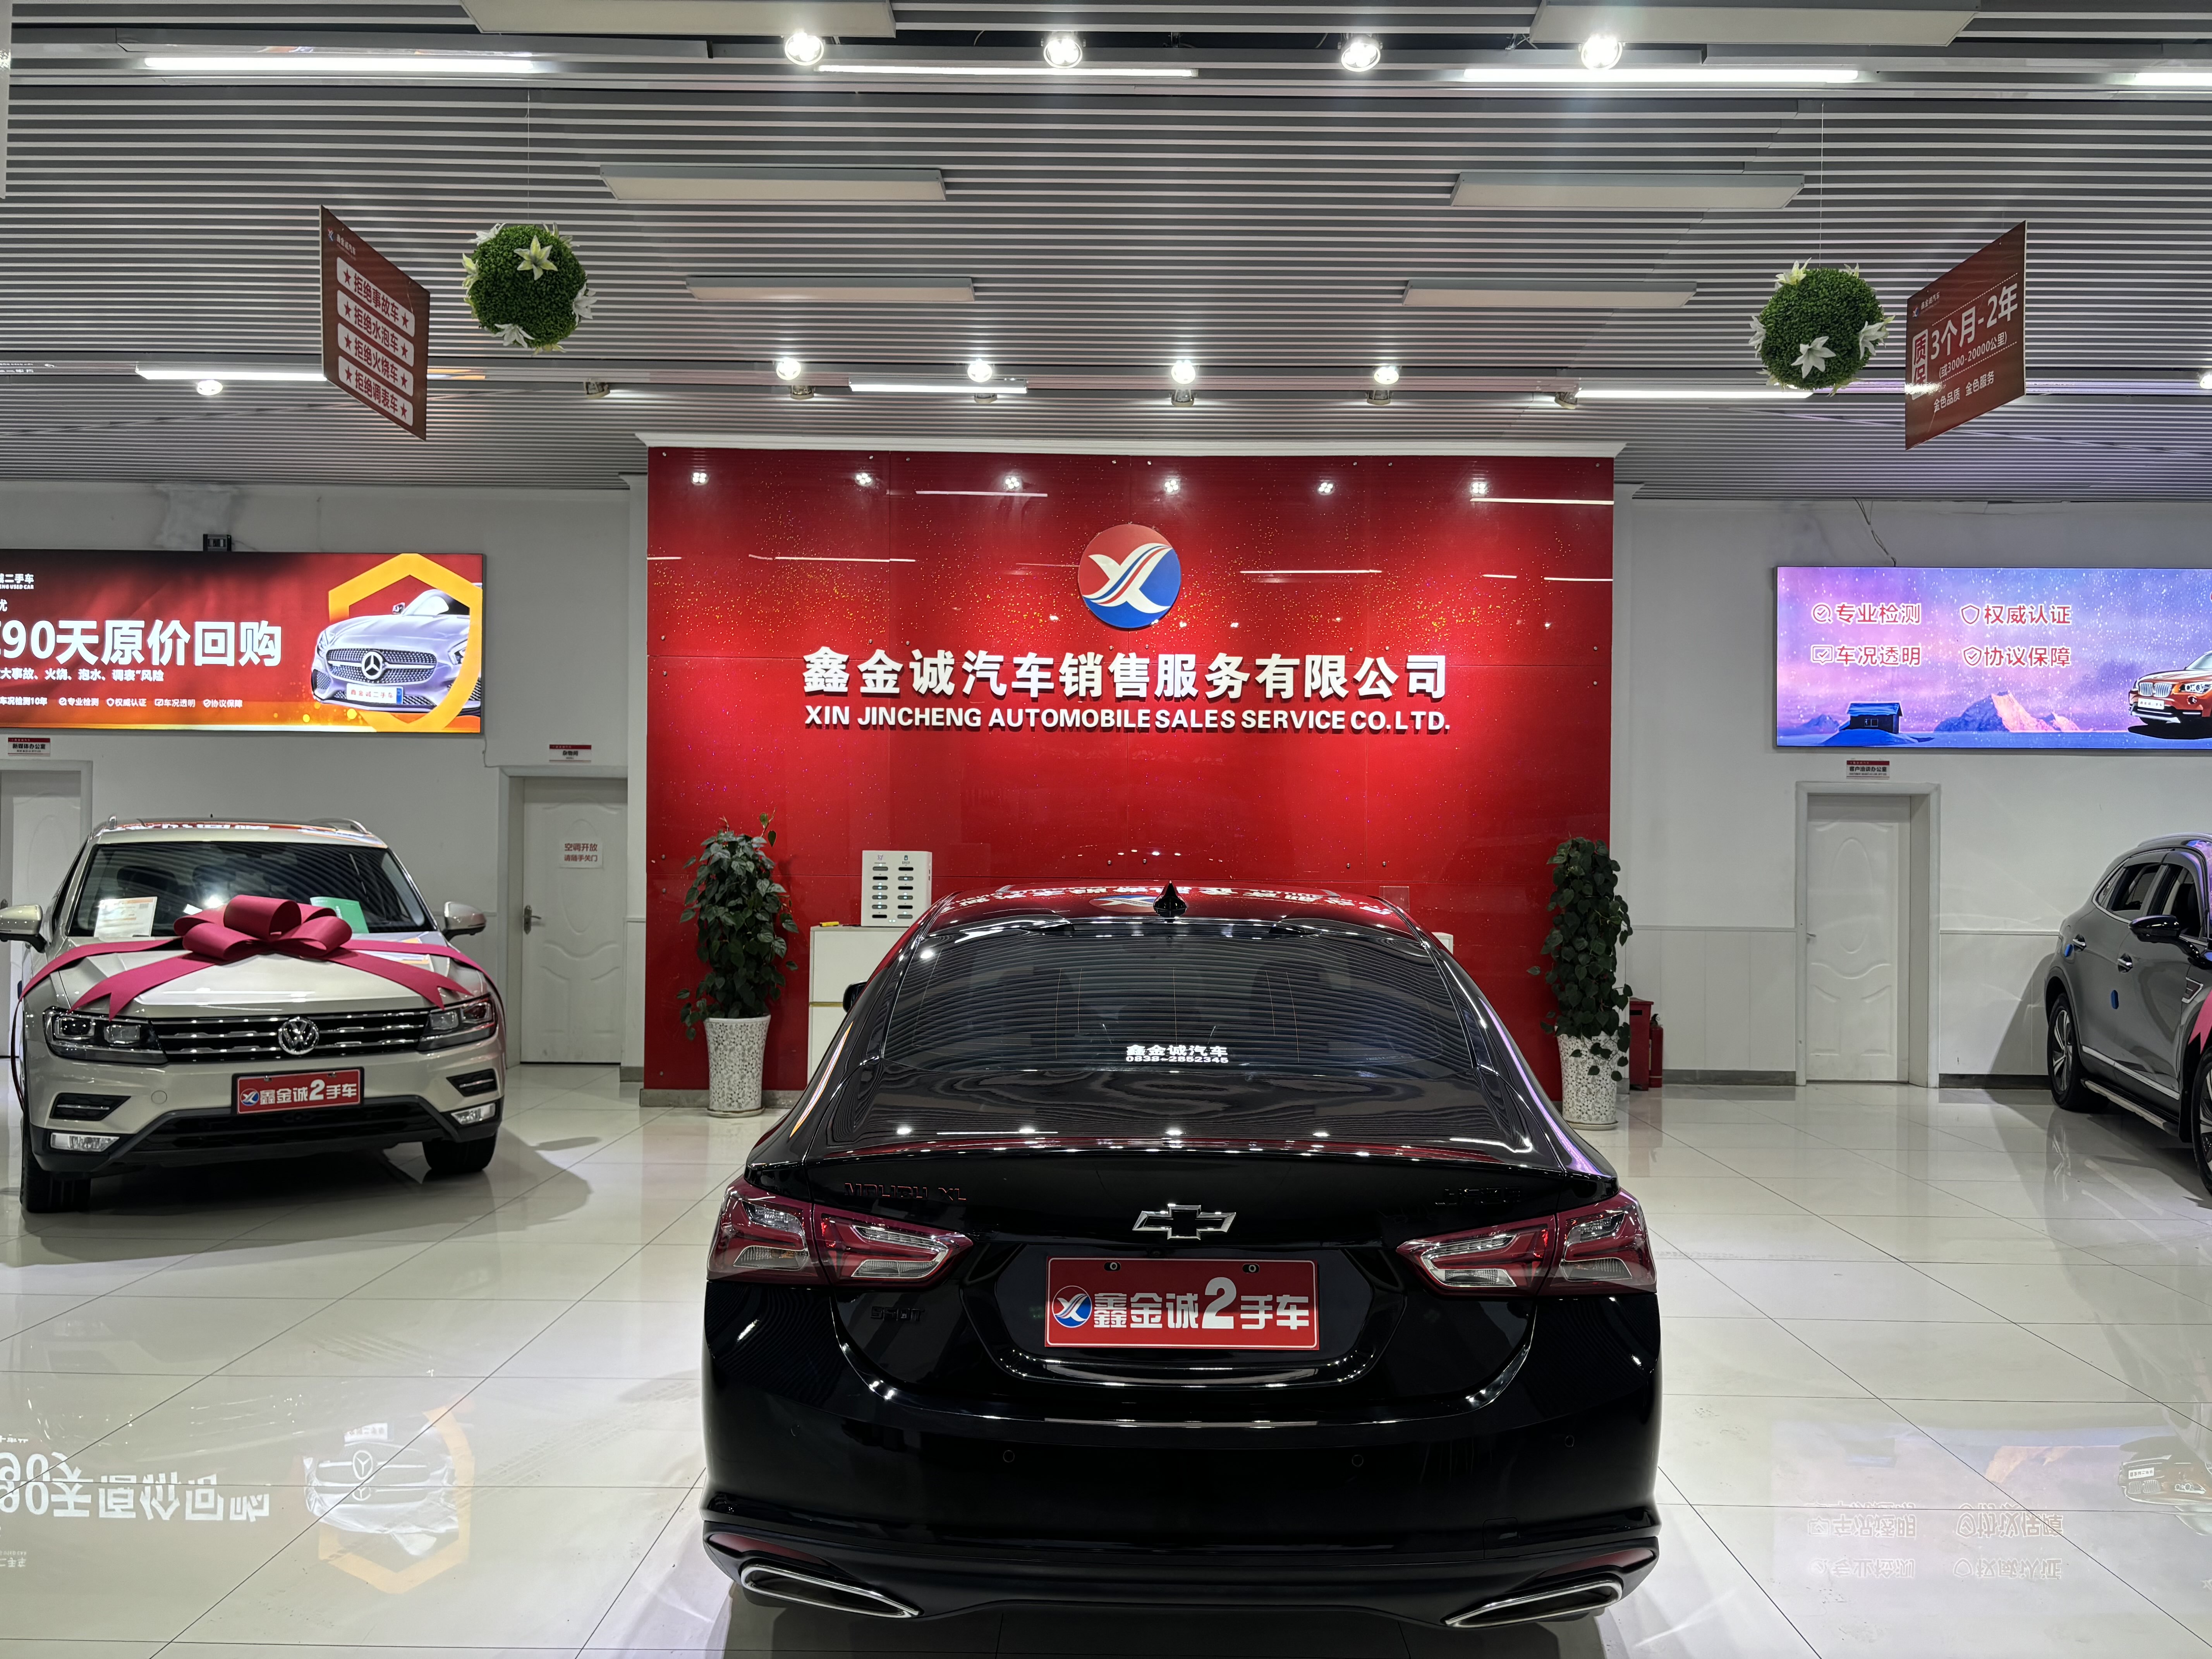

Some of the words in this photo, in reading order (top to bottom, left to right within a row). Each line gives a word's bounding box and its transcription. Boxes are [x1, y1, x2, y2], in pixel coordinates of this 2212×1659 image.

[354, 273, 398, 322] 拒绝事故车
[354, 305, 398, 353] 拒绝水泡车
[1930, 282, 2018, 360] 3个月-2年
[354, 337, 398, 384] 拒绝火烧车
[355, 370, 398, 414] 拒绝调表车
[1933, 387, 1960, 413] 金色品质
[1965, 370, 1994, 396] 金色服务
[1836, 603, 1922, 625] 专业检测
[1984, 605, 2072, 626] 权威认证
[0, 619, 282, 666] 90天原价回购
[1836, 644, 1922, 668] 车况透明
[1983, 646, 2072, 668] 协议保障
[802, 646, 1446, 699] 鑫金诚汽车销售服务有限公司
[67, 697, 99, 707] 专业检测
[115, 698, 147, 708] 权威认证
[164, 699, 196, 708] 车况透明
[211, 699, 243, 708] 协议保障
[804, 705, 850, 725] XIN
[857, 706, 981, 727] JINCHENG
[988, 708, 1150, 728] AUTOMOBILE
[1155, 709, 1235, 729] SALES
[1241, 710, 1345, 730] SERVICE
[564, 843, 598, 852] 空调开放
[1126, 1044, 1228, 1057] 鑫金诚汽车
[259, 1079, 357, 1105] 鑫金诚2手车
[1093, 1276, 1310, 1330] 鑫金诚2手车
